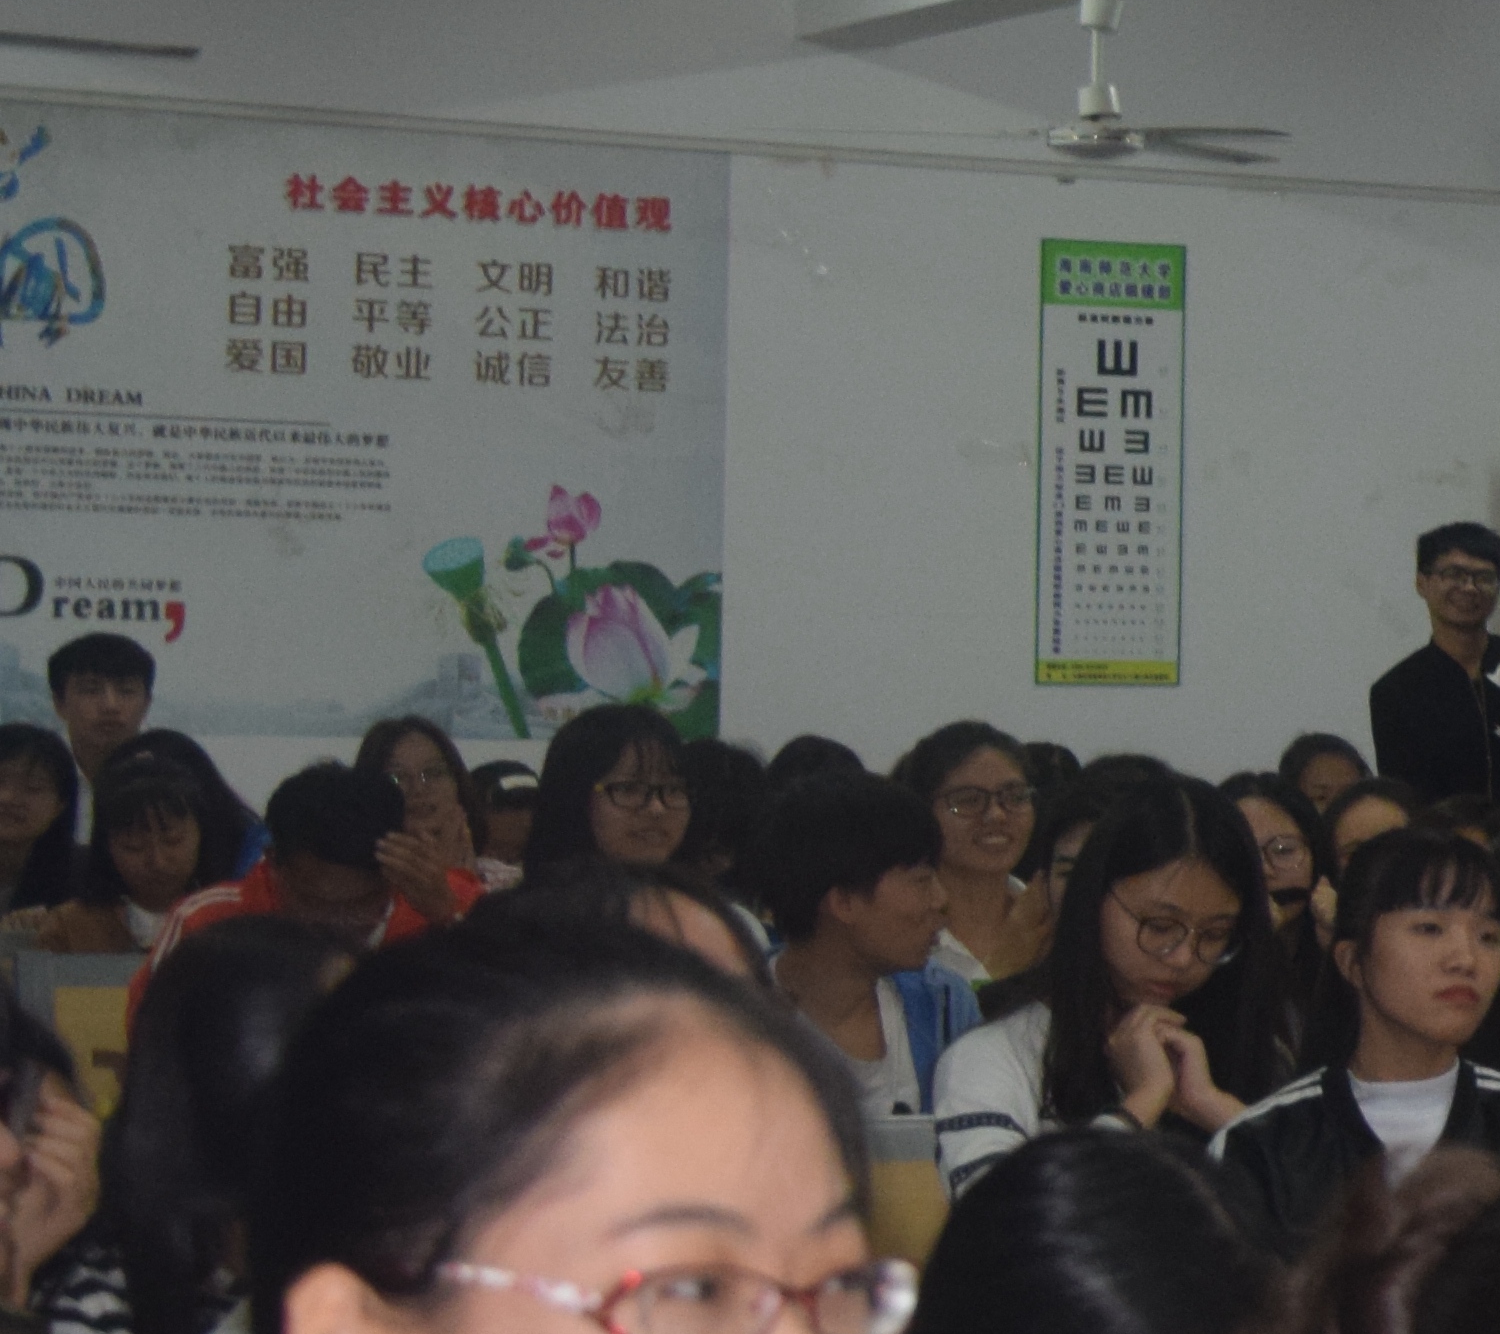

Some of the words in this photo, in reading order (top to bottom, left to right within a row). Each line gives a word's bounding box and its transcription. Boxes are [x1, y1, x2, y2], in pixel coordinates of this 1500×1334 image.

[285, 173, 672, 232] 社会主义核心价值观
[227, 244, 310, 284] 富强
[355, 251, 434, 289] 民主
[476, 258, 554, 297] 文明
[595, 267, 671, 304] 和谐
[228, 291, 307, 329] 自由
[351, 297, 432, 336] 平等
[474, 305, 554, 342] 公正
[594, 311, 670, 348] 法治
[225, 338, 307, 375] 爱国
[351, 344, 432, 381] 敬业
[474, 350, 552, 388] 诚信
[592, 356, 669, 393] 友善
[66, 387, 143, 406] DREAM
